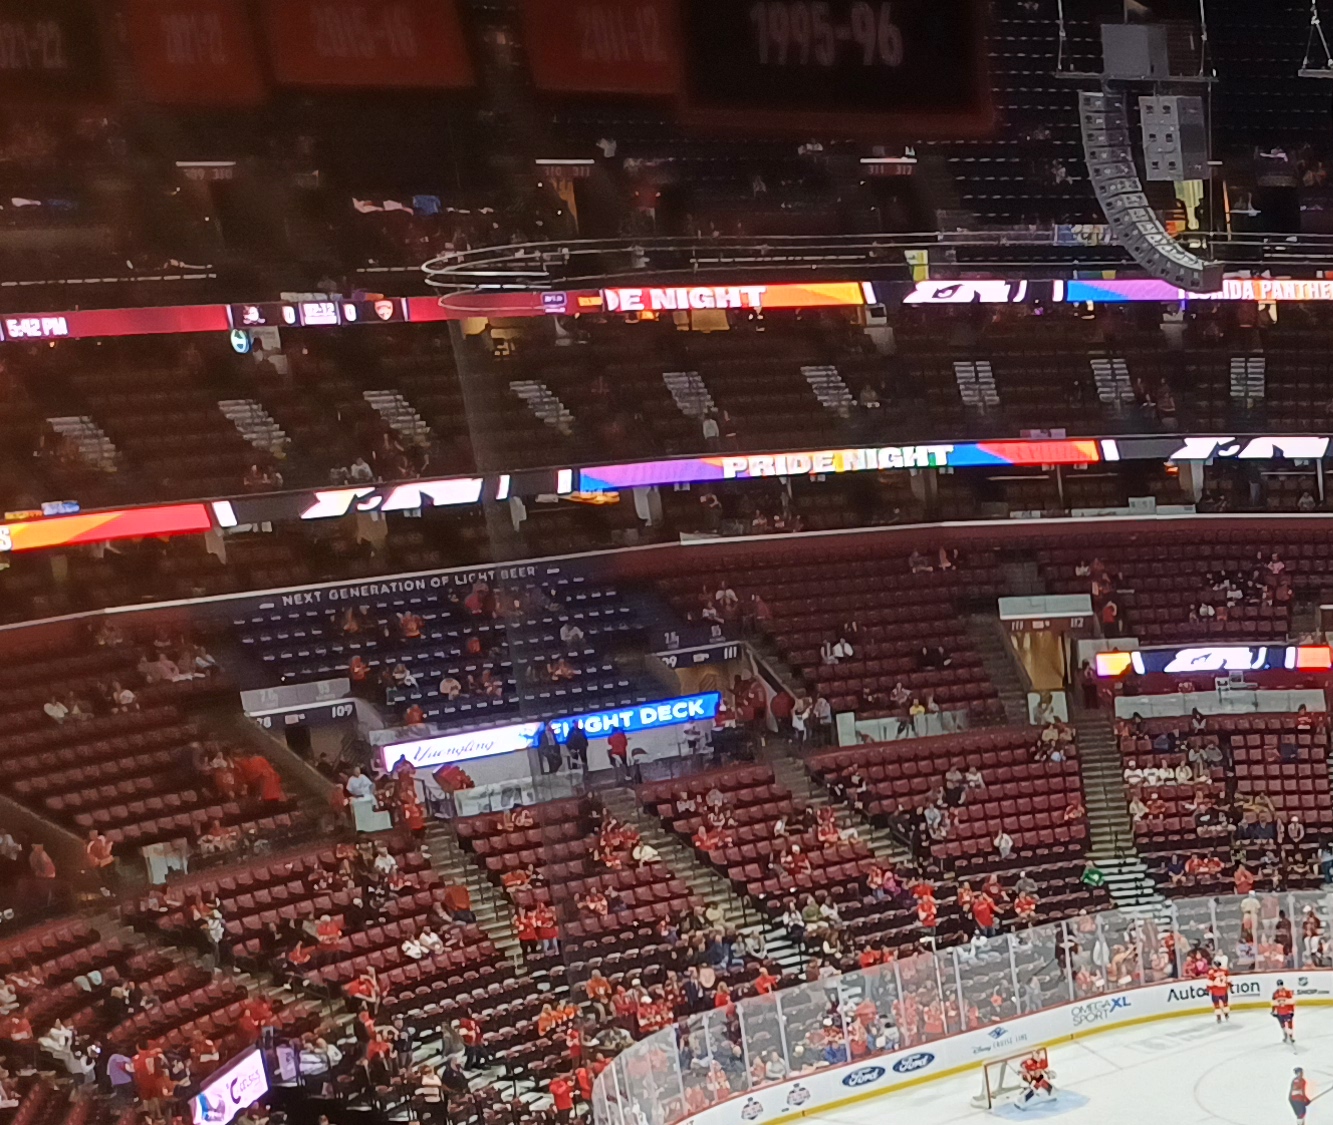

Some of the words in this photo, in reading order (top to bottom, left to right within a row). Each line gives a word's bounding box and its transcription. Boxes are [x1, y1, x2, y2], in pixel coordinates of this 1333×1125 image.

[751, 2, 903, 66] 1995-96
[651, 286, 767, 310] NIGHT
[42, 317, 68, 336] PM
[722, 451, 835, 479] PRIDE
[841, 445, 954, 472] NIGHT
[282, 591, 323, 607] NEXT
[328, 578, 427, 602] GENERATION
[430, 575, 450, 589] OF
[331, 705, 353, 718] 109
[641, 697, 705, 724] DECK
[1167, 982, 1260, 1002] Autotion
[1109, 997, 1131, 1012] XL
[897, 1053, 934, 1072] Ford
[849, 1067, 883, 1086] Ford
